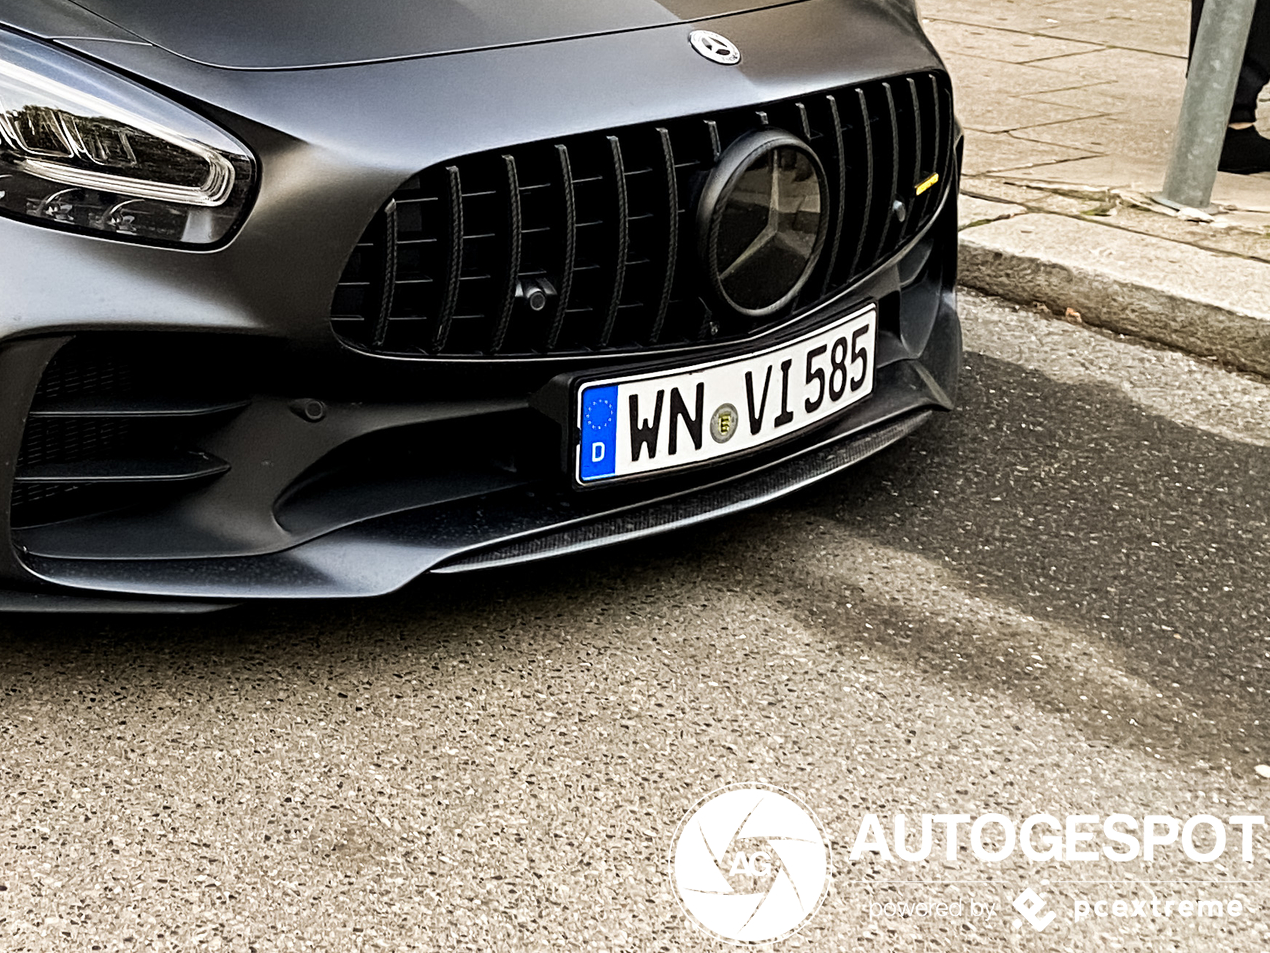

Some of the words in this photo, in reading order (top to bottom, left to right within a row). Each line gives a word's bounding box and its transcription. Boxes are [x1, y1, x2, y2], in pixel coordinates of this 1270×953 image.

[628, 382, 705, 462] WN
[744, 358, 793, 436] VI
[804, 323, 870, 414] 585
[592, 441, 605, 463] D
